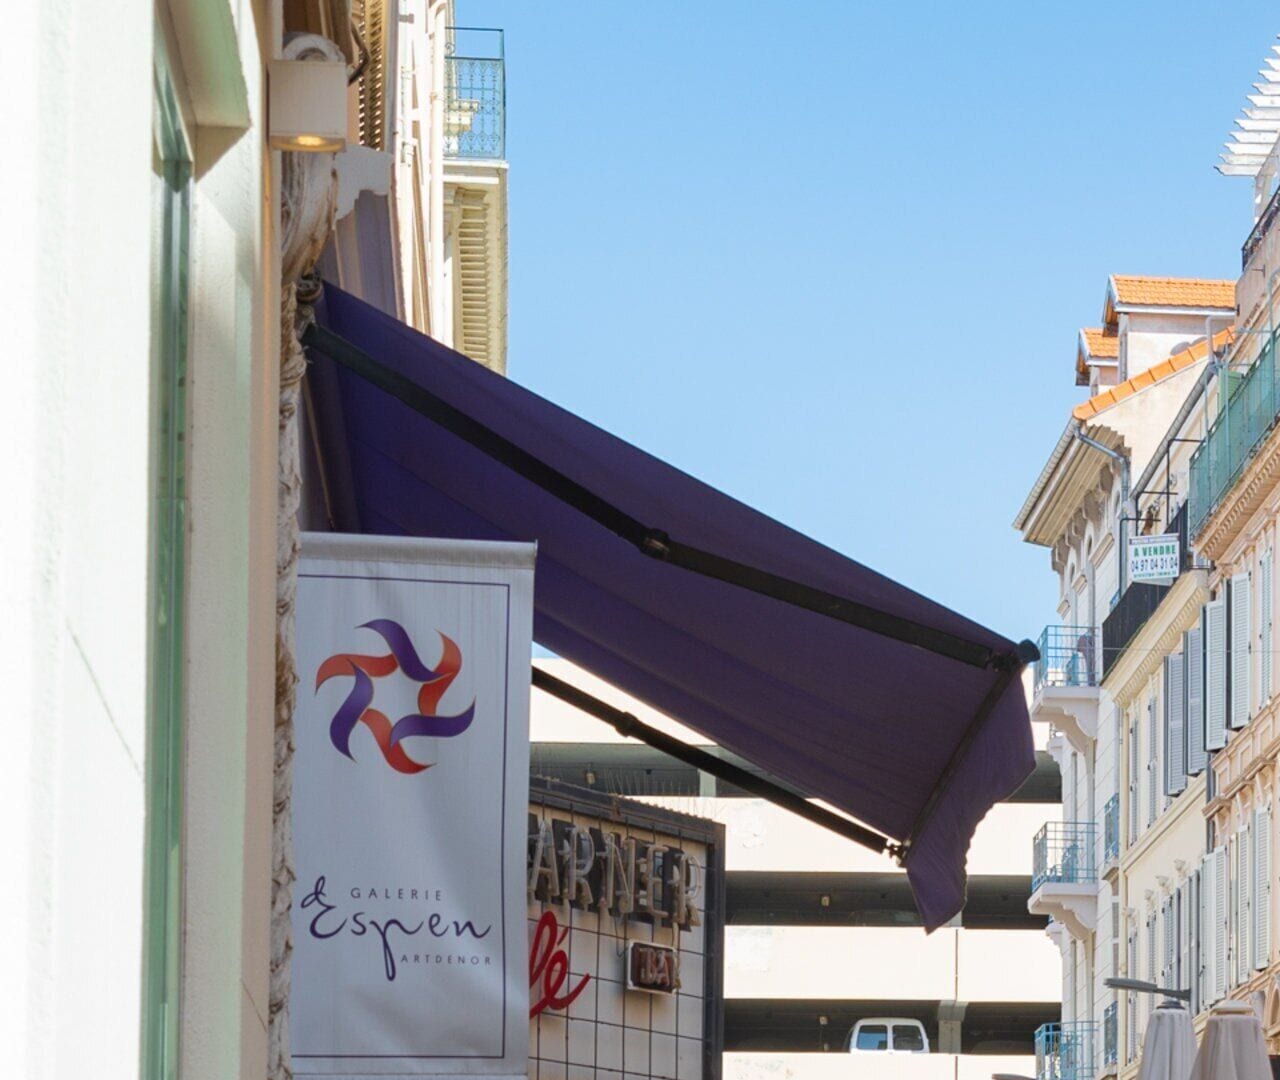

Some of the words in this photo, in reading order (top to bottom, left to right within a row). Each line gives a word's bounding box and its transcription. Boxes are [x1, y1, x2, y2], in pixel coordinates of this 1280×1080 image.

[1142, 544, 1176, 557] VENDRE
[350, 887, 443, 901] GALERIE
[401, 953, 492, 966] ARTDENOR
